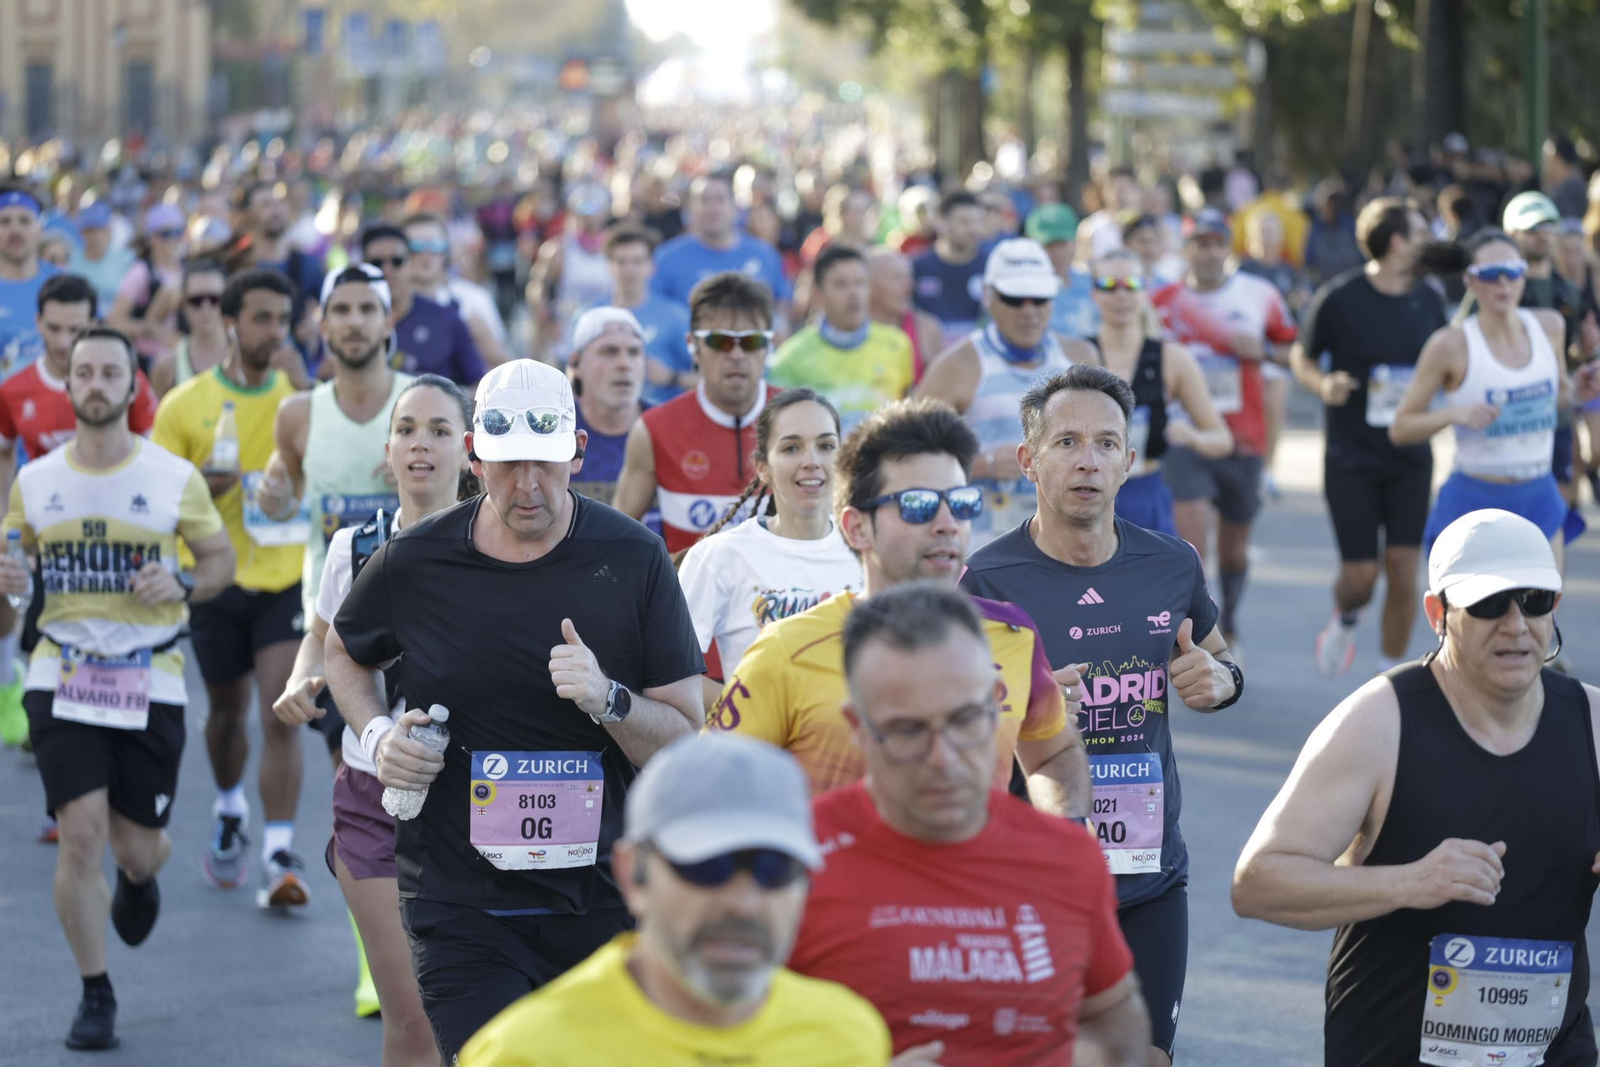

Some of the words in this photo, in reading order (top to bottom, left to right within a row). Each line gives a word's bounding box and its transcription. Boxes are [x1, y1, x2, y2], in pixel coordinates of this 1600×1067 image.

[1086, 625, 1121, 636] ZURICH
[57, 684, 121, 708] ALVARO
[1080, 669, 1166, 707] ADRID
[1084, 736, 1115, 746] THON
[1120, 733, 1144, 743] 2024
[516, 759, 589, 774] ZURICH
[1088, 762, 1150, 779] ZURICH
[518, 794, 556, 809] 8103
[1093, 798, 1117, 814] 021
[520, 816, 553, 840] OG
[1092, 820, 1127, 844] AO
[909, 942, 1024, 983] MÁLAGA
[1484, 946, 1560, 967] ZURICH
[1478, 986, 1529, 1006] 10995
[1423, 1020, 1500, 1043] DOMINGO
[1503, 1026, 1560, 1044] MORENO
